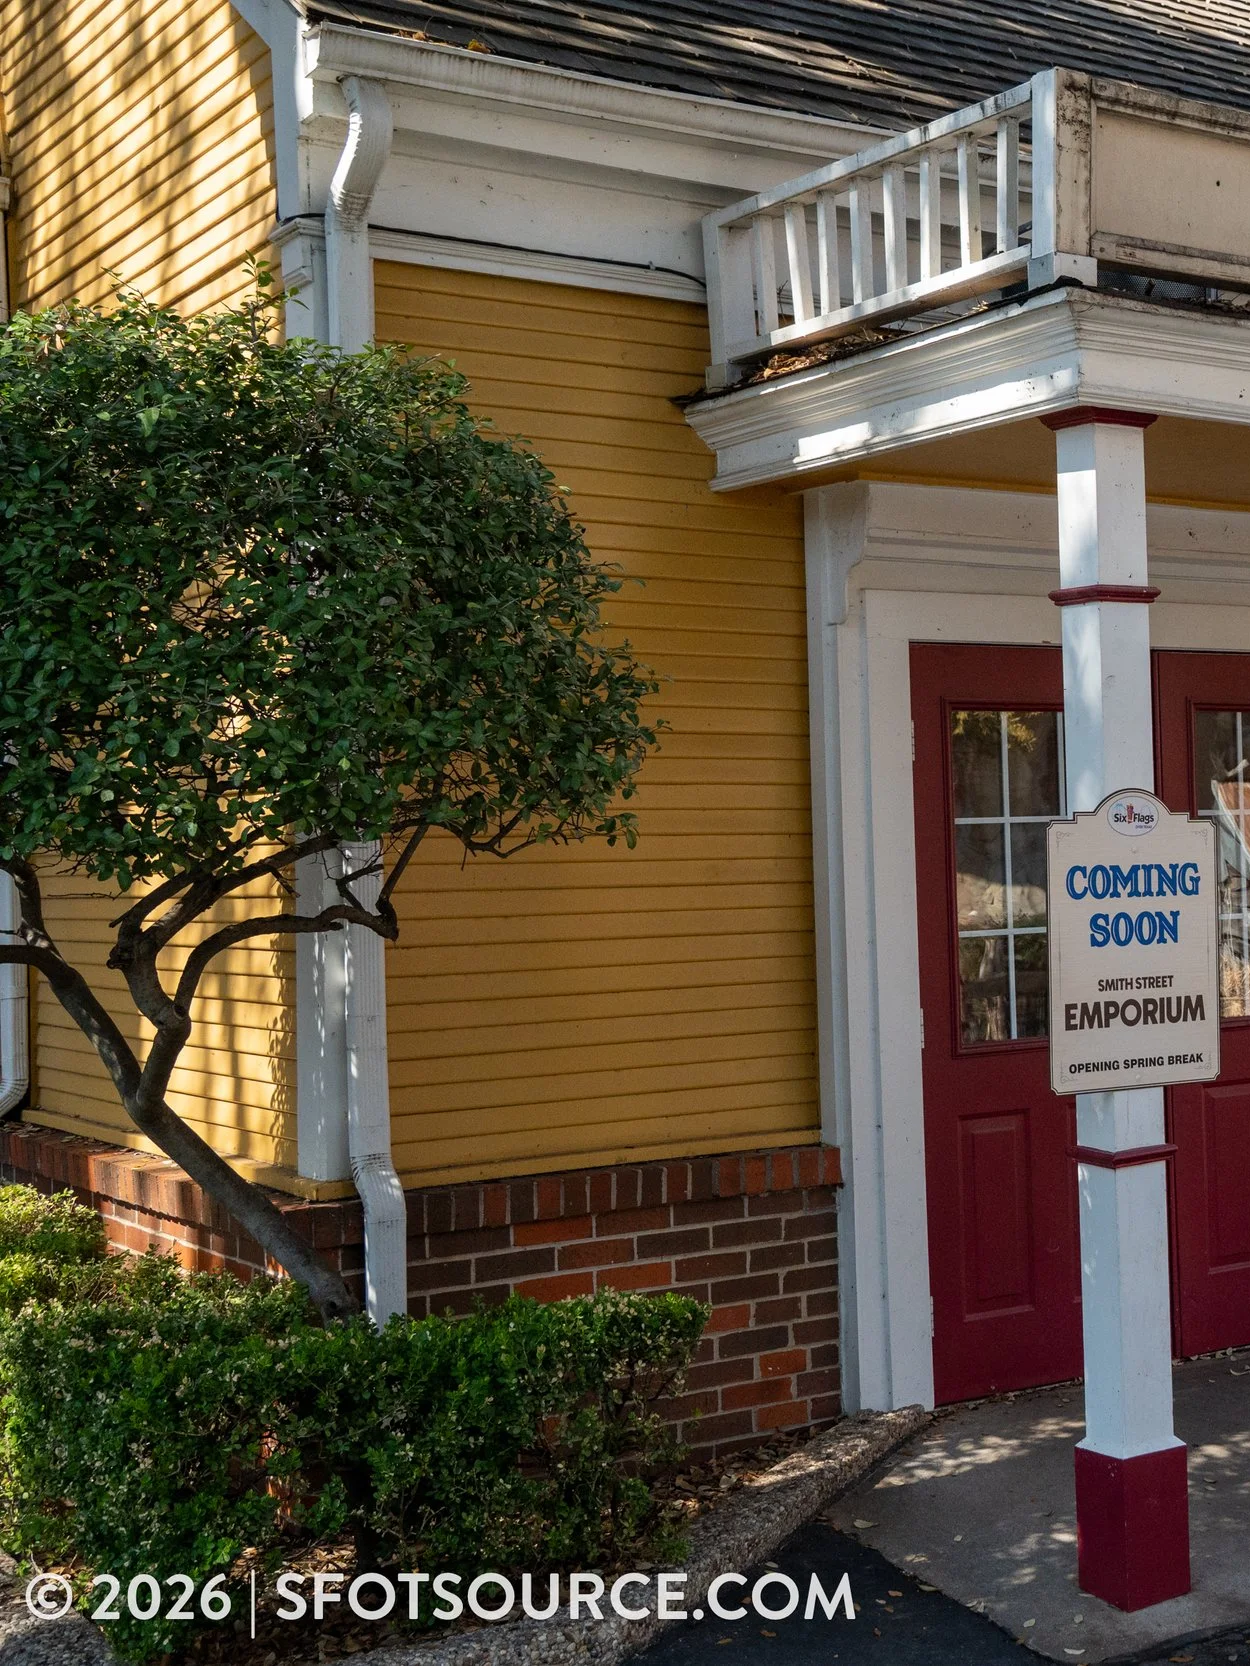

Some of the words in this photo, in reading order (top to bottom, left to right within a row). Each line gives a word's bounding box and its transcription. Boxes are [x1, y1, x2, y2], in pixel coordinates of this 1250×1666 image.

[1113, 813, 1127, 823] Six
[1133, 813, 1154, 824] Flags
[1066, 862, 1201, 900] COMING
[1089, 910, 1181, 947] SOON
[1098, 978, 1134, 992] SMITH
[1135, 975, 1174, 990] STREET
[1064, 994, 1206, 1032] EMPORIUM
[1069, 1060, 1120, 1074] OPENING
[1123, 1056, 1165, 1069] SPRING
[1167, 1053, 1204, 1065] BREAK
